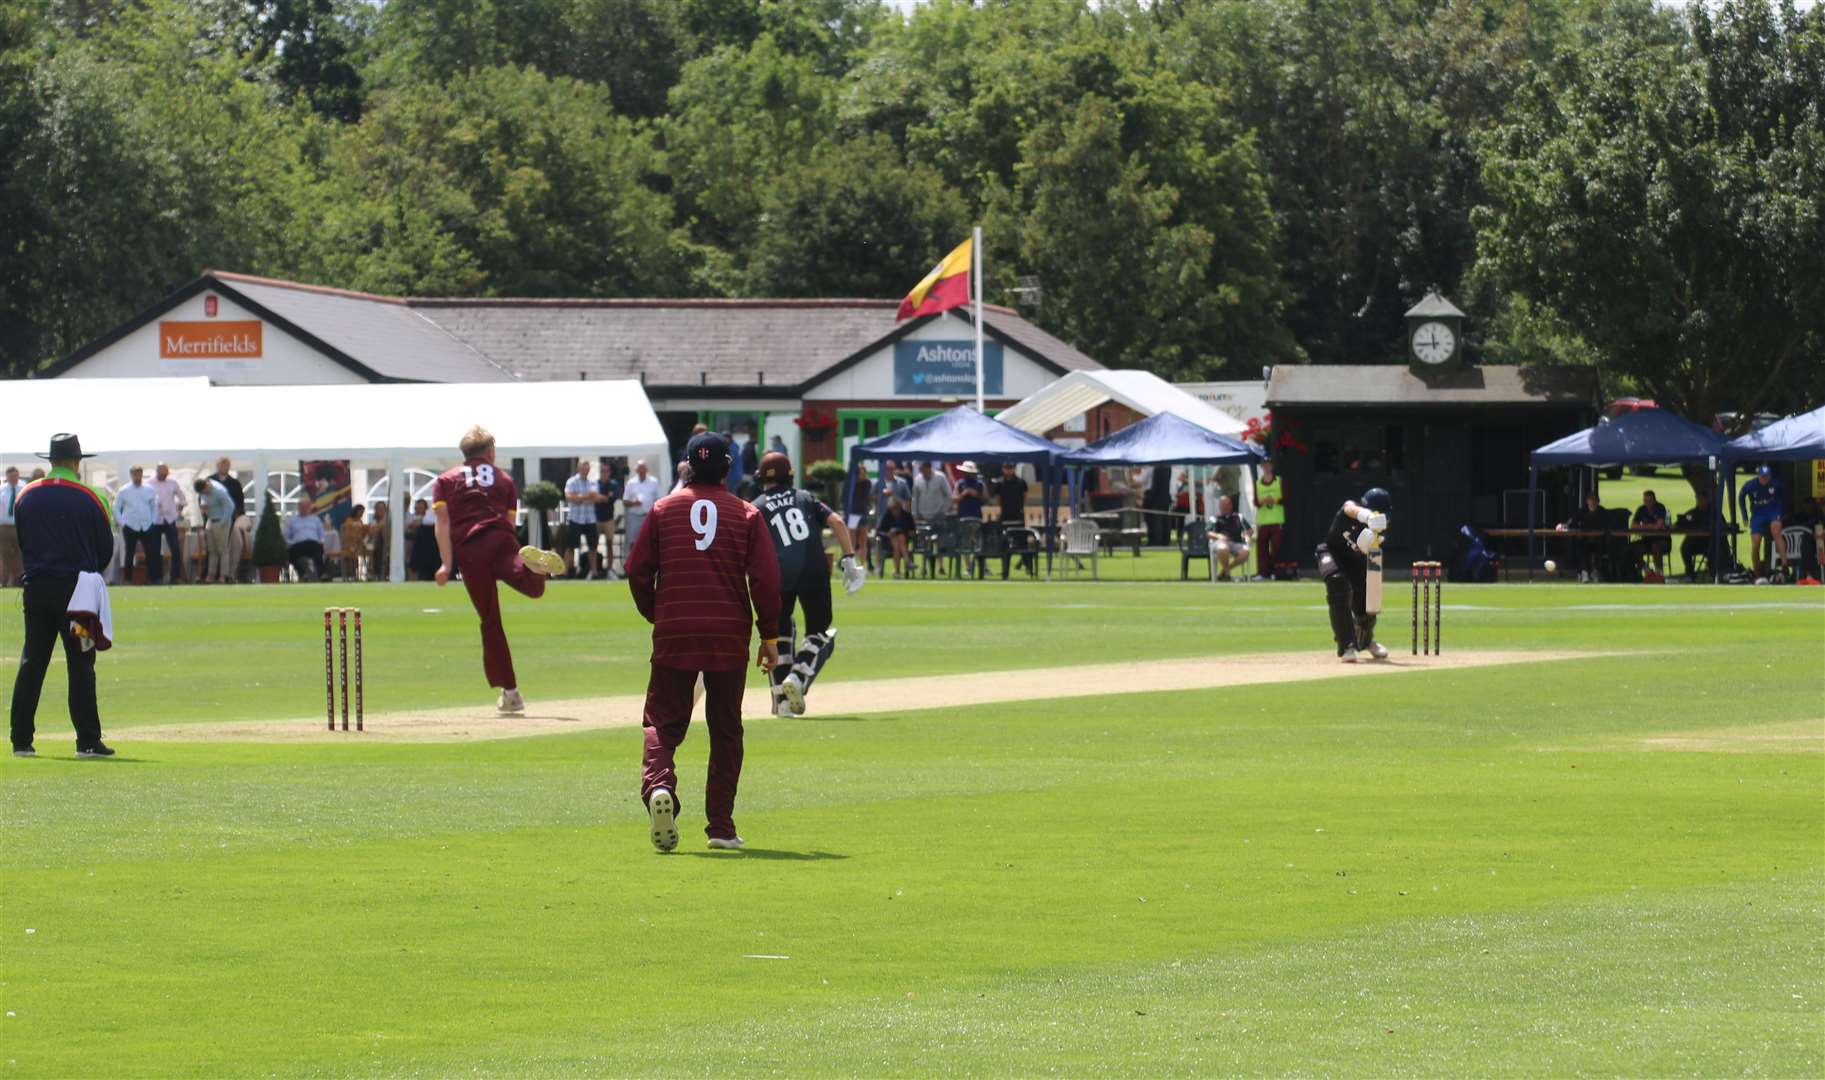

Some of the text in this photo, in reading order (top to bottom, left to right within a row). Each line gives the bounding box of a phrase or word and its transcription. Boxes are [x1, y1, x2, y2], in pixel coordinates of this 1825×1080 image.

[166, 334, 256, 353] Merrifields
[460, 464, 494, 487] 18
[765, 496, 795, 512] BLAKE
[690, 499, 717, 551] 9
[770, 507, 810, 547] 18
